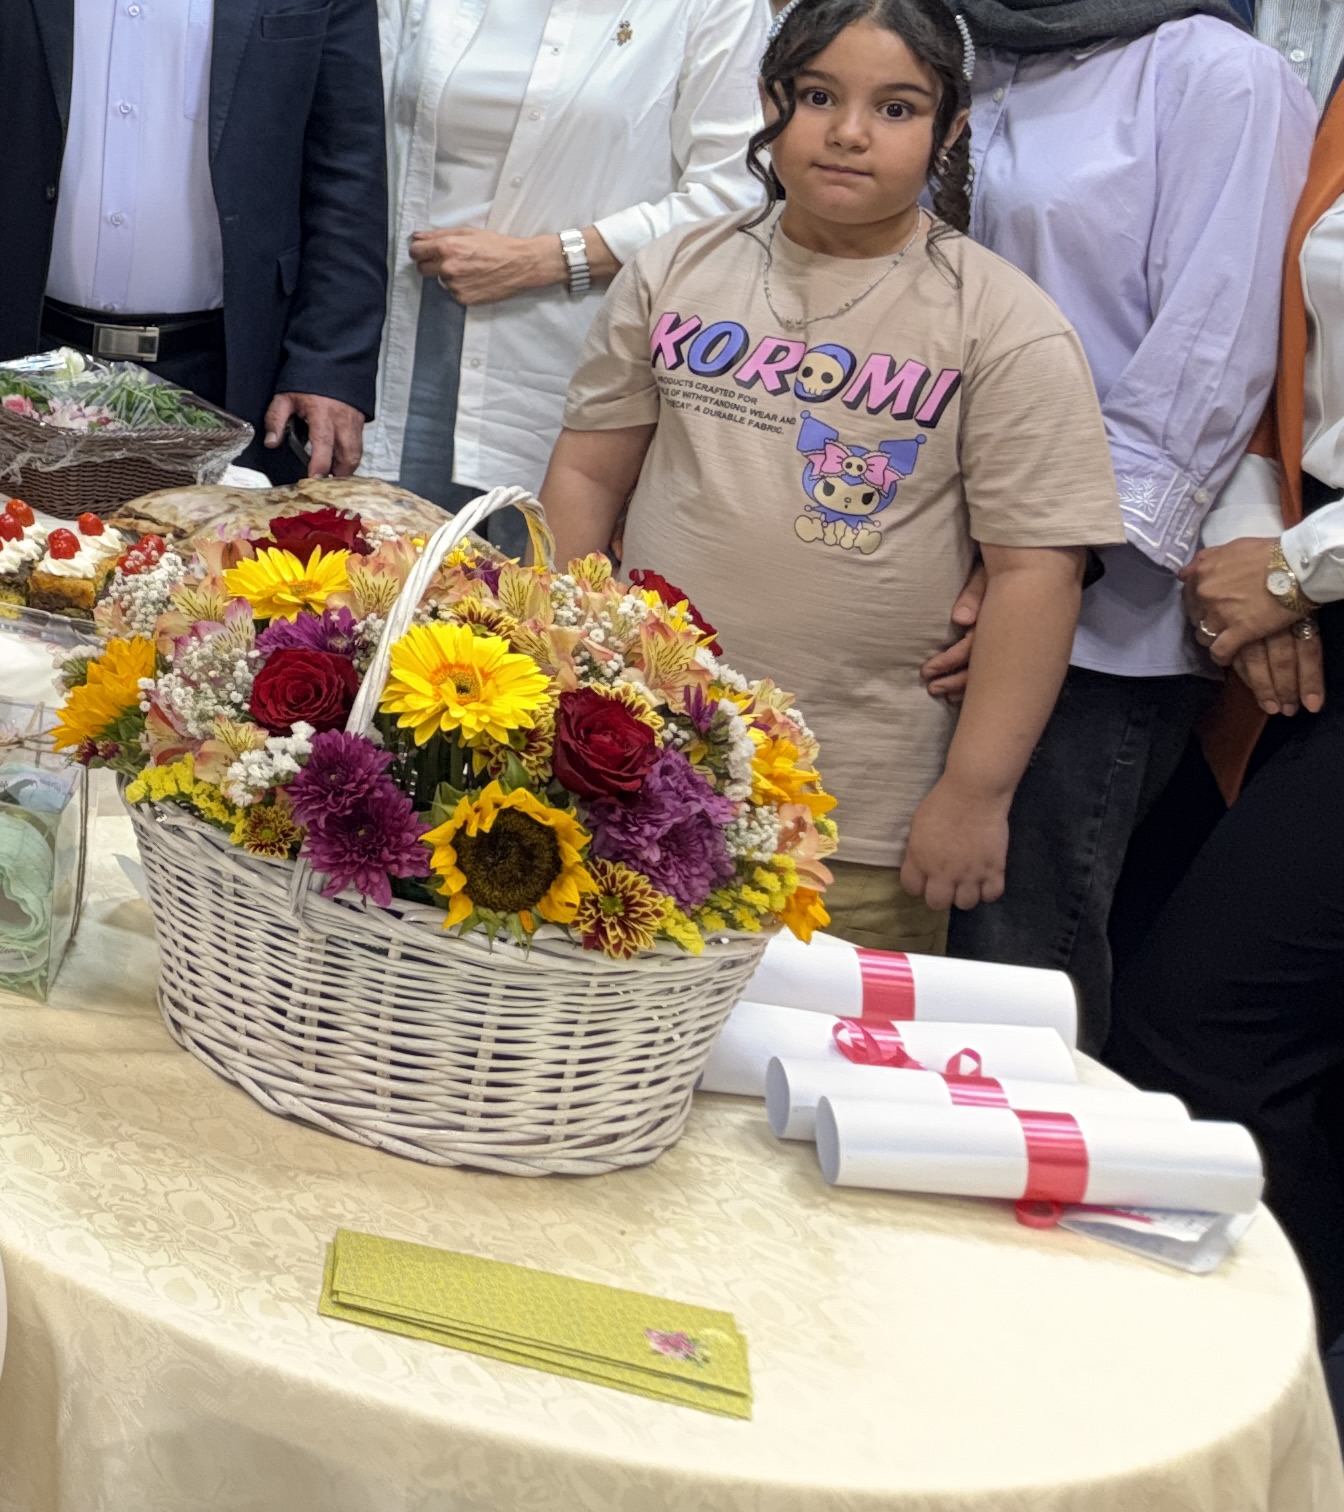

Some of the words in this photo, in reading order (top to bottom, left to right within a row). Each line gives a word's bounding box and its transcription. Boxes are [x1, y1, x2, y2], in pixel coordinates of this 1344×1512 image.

[650, 311, 962, 429] KOROMI
[695, 382, 736, 399] CRAFTED
[737, 393, 758, 405] FOR
[703, 407, 746, 425] DURABLE
[749, 408, 778, 422] WEAR
